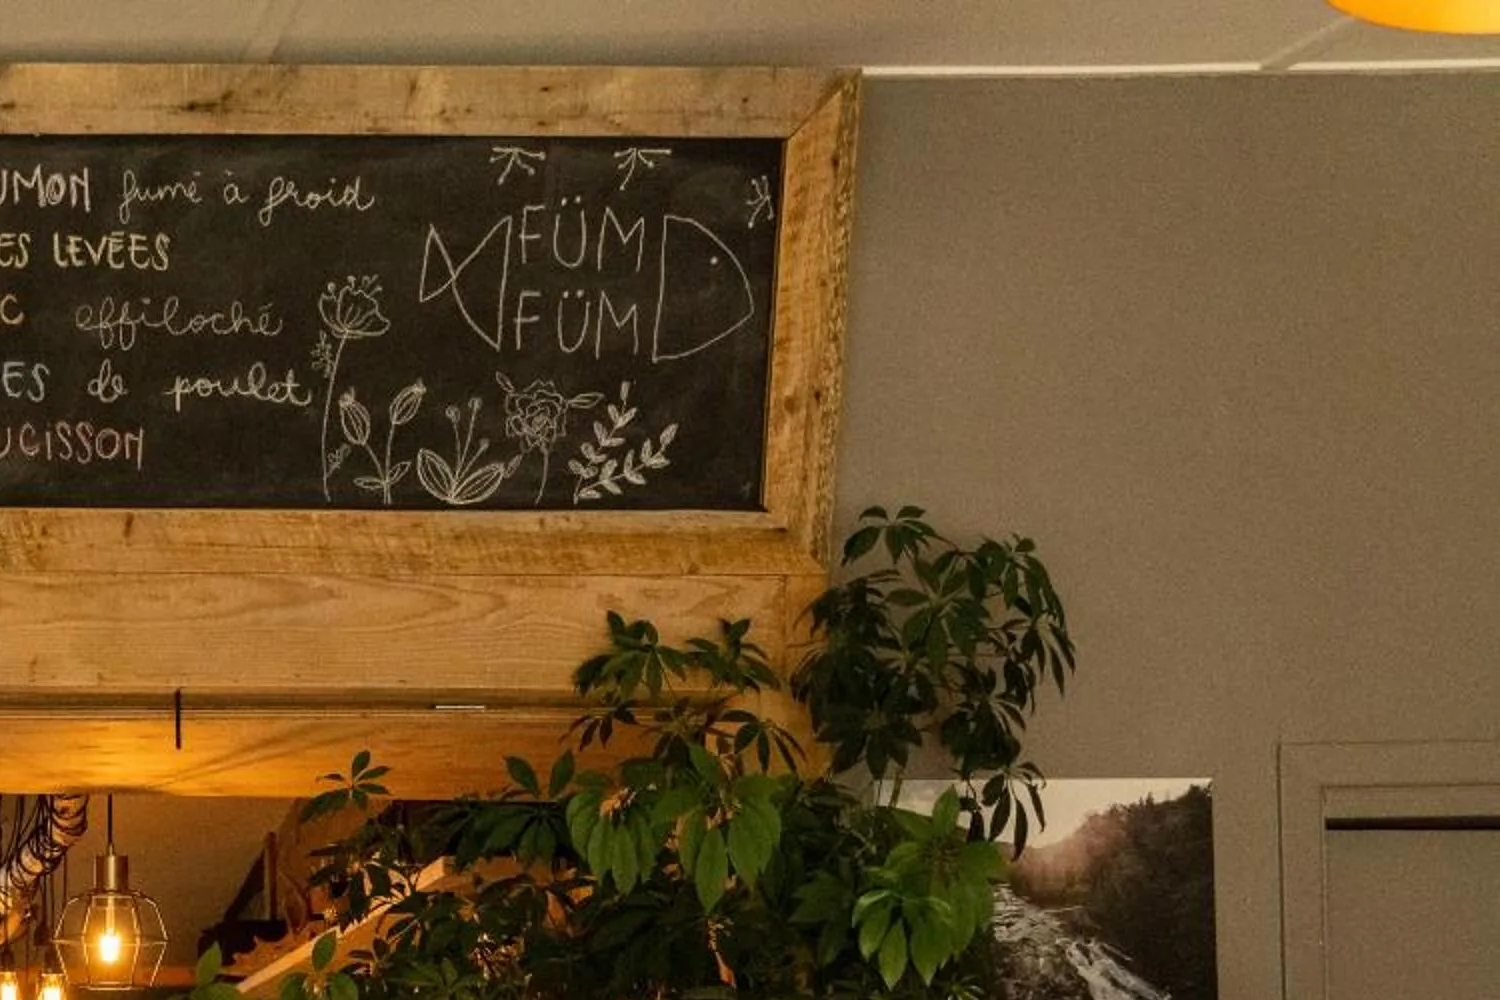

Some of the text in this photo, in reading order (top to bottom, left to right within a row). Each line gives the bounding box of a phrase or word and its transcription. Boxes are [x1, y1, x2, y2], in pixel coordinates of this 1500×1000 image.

[223, 170, 247, 205] à
[258, 176, 376, 226] froid
[519, 195, 645, 272] FÜM
[75, 296, 283, 351] effiloché
[514, 289, 640, 360] FÜM
[87, 359, 127, 403] de
[162, 362, 313, 412] poulet
